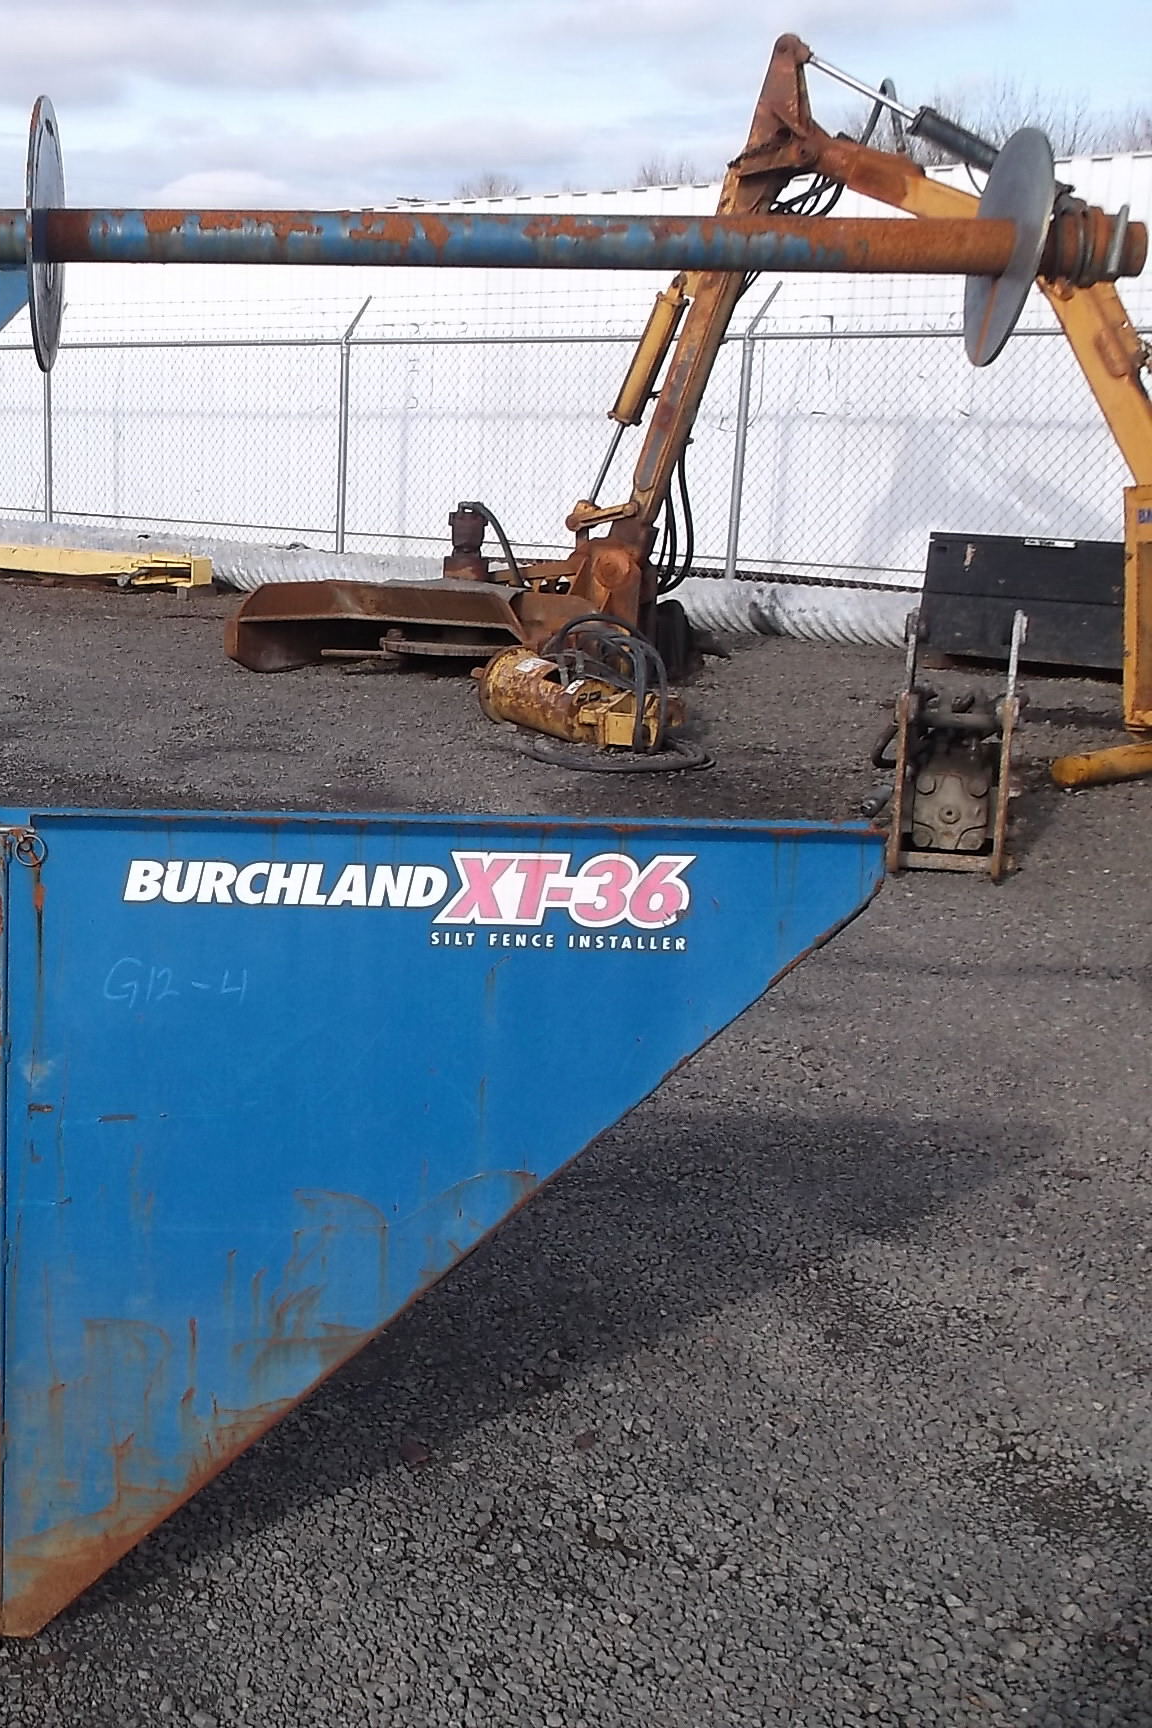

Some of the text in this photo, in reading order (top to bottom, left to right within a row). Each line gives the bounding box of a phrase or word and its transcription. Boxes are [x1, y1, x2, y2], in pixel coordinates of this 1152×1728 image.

[123, 851, 696, 929] BURCHLAND XT-36
[430, 931, 687, 951] SILT FENCE INSTALLER
